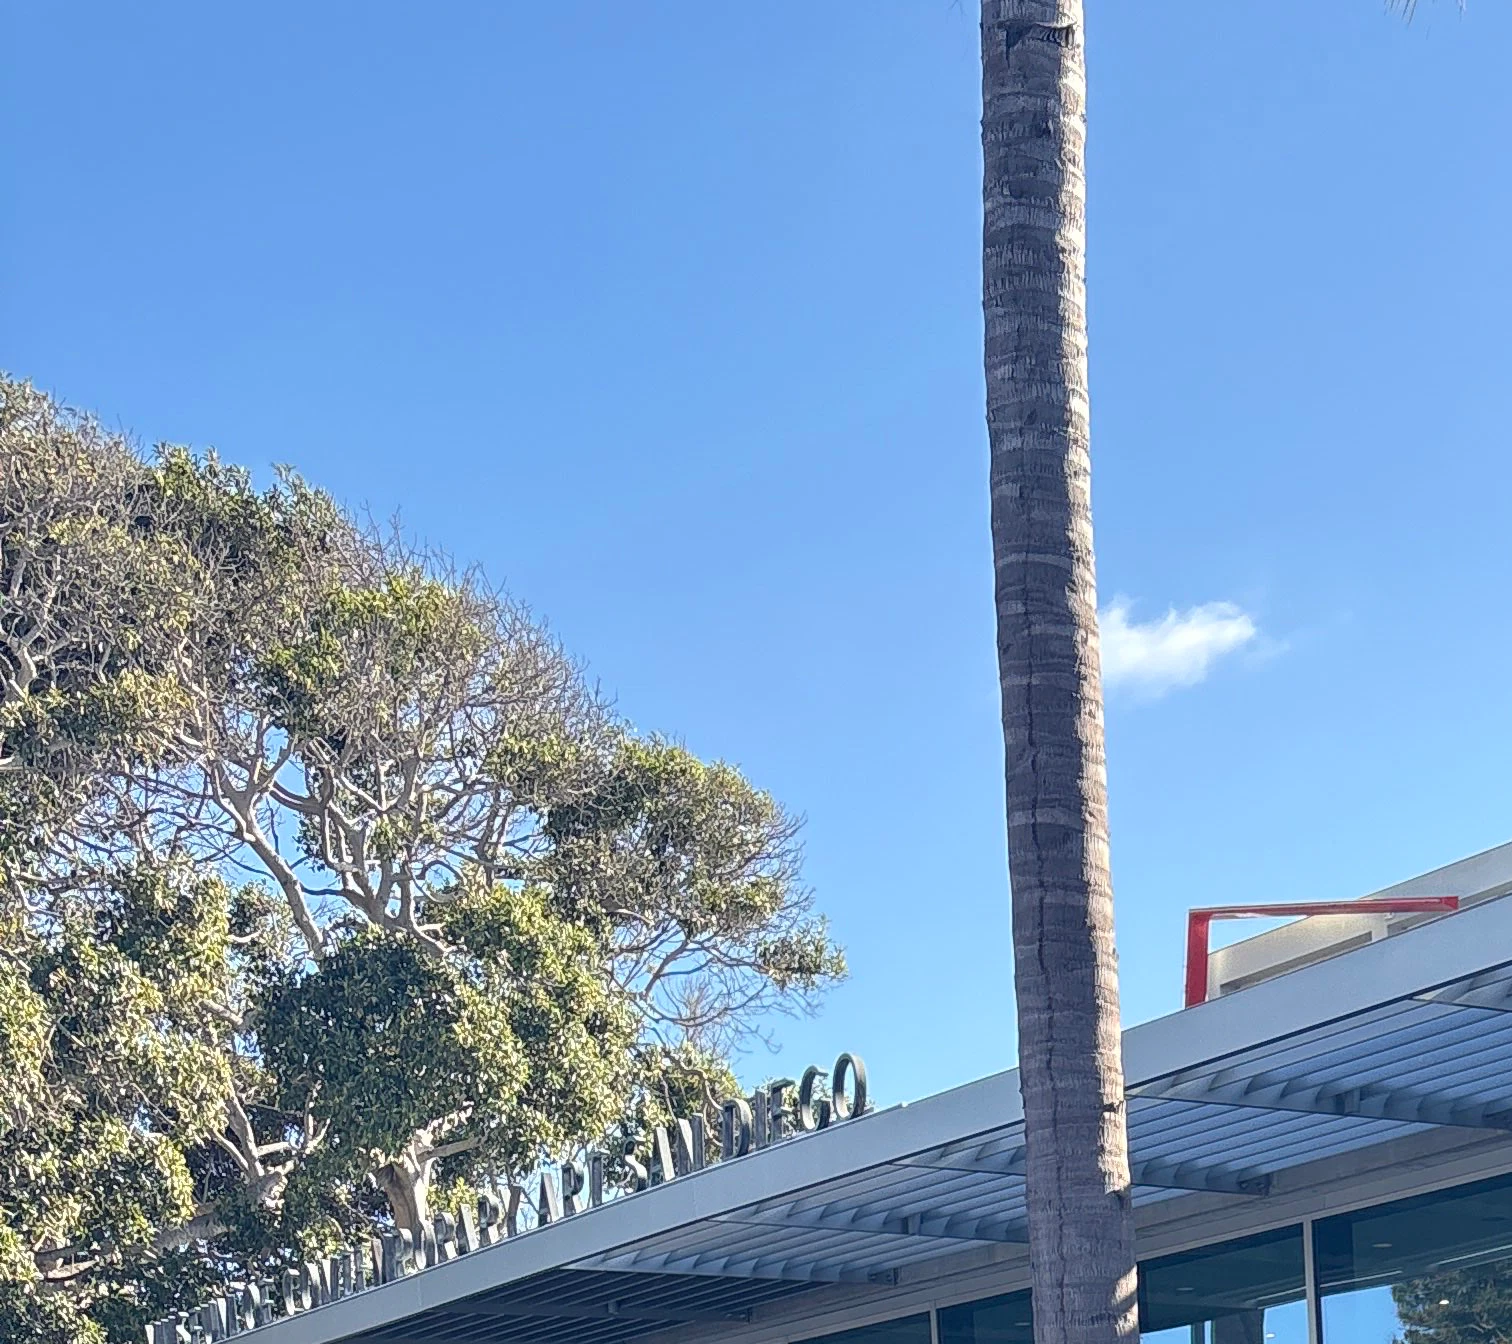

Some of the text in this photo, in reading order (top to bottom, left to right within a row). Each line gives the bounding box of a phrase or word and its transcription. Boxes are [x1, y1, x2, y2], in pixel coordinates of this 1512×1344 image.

[538, 1152, 603, 1226] ART
[622, 1113, 705, 1191] SAN
[722, 1052, 868, 1161] DIEGO
